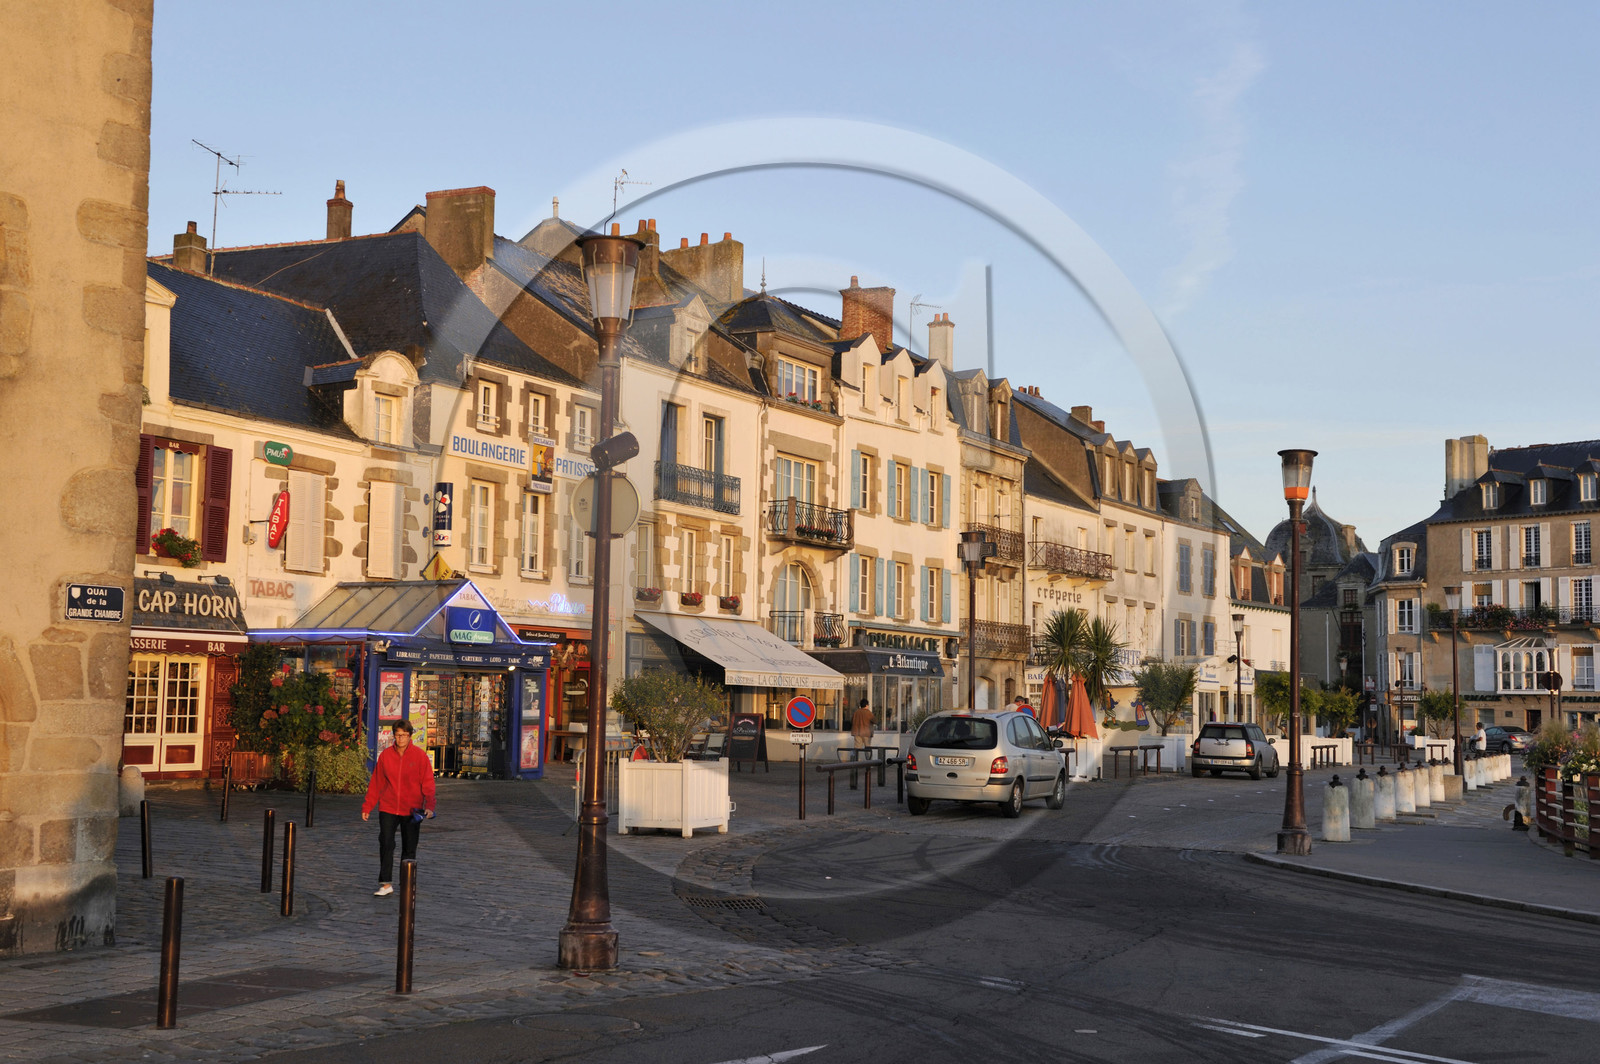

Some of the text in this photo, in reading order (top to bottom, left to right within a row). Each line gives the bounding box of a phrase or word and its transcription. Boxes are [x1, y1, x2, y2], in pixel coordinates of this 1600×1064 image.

[168, 441, 180, 449] BAR
[266, 448, 281, 458] PMU
[452, 435, 598, 477] BOULANGERIE PATISSE
[268, 498, 285, 541] TABAC
[86, 587, 108, 596] QUAI
[249, 580, 295, 599] TABAC
[1037, 582, 1082, 606] crêperie
[458, 592, 478, 601] TABAC
[138, 589, 237, 619] CAP HORN
[68, 607, 122, 619] GRANDE CHAMBRE
[453, 631, 472, 641] MAG
[207, 643, 226, 653] BAR
[867, 632, 941, 654] PHARMACIE
[396, 651, 421, 659] LIBRAIRIE
[429, 653, 454, 661] PAPETERIE
[461, 655, 483, 663] CARTERIE
[726, 674, 755, 685] BRASSERIE
[758, 674, 768, 685] LA
[768, 675, 809, 688] CROISICAISE
